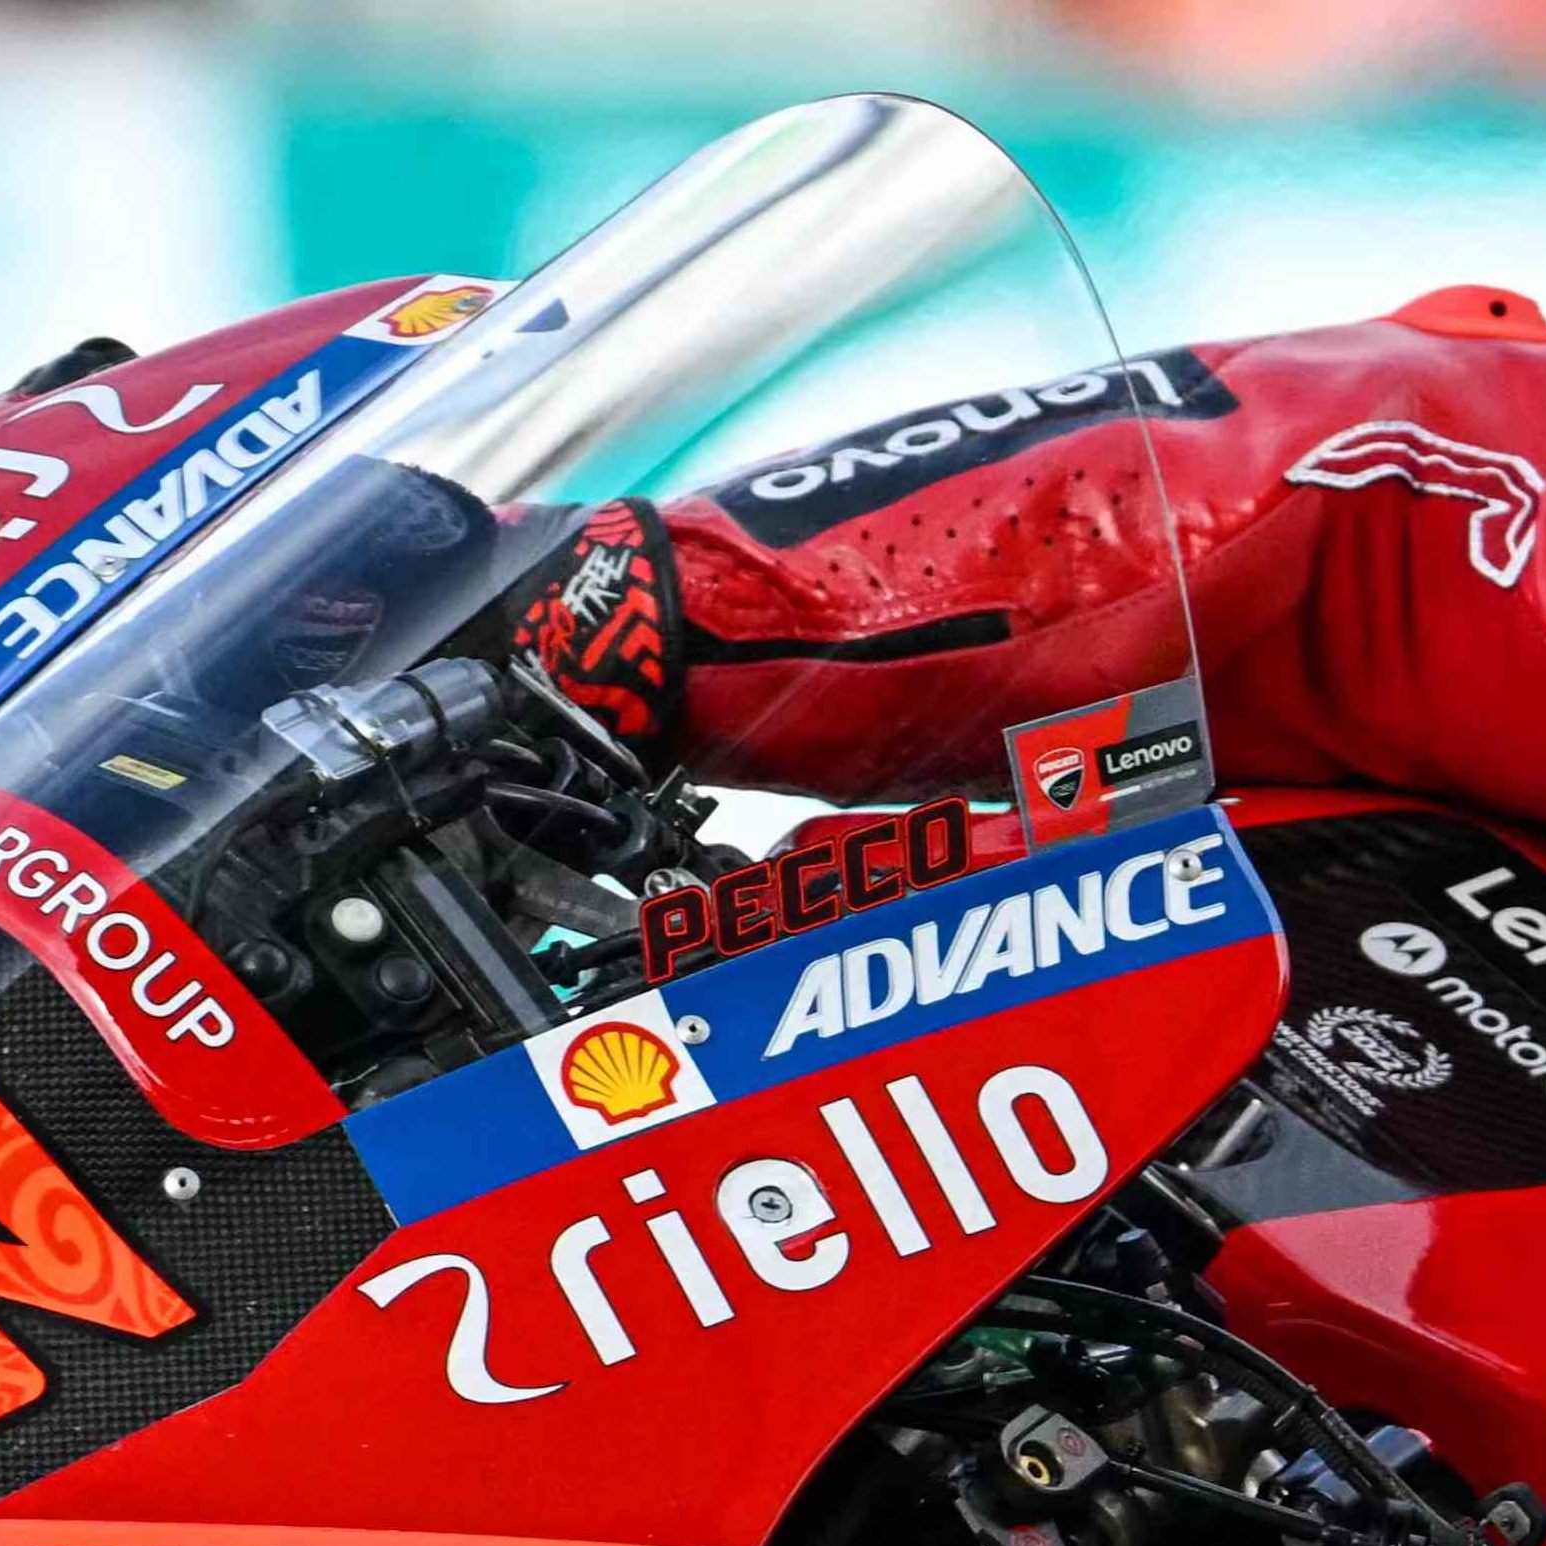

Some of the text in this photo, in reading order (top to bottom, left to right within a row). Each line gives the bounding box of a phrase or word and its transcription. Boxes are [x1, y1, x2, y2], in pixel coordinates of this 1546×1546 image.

[749, 358, 1184, 501] Lenovo
[1105, 735, 1193, 774] Lenovo
[641, 796, 973, 984] PECCO
[762, 833, 1228, 1062] ADVANCE
[551, 1064, 1110, 1368] riello
